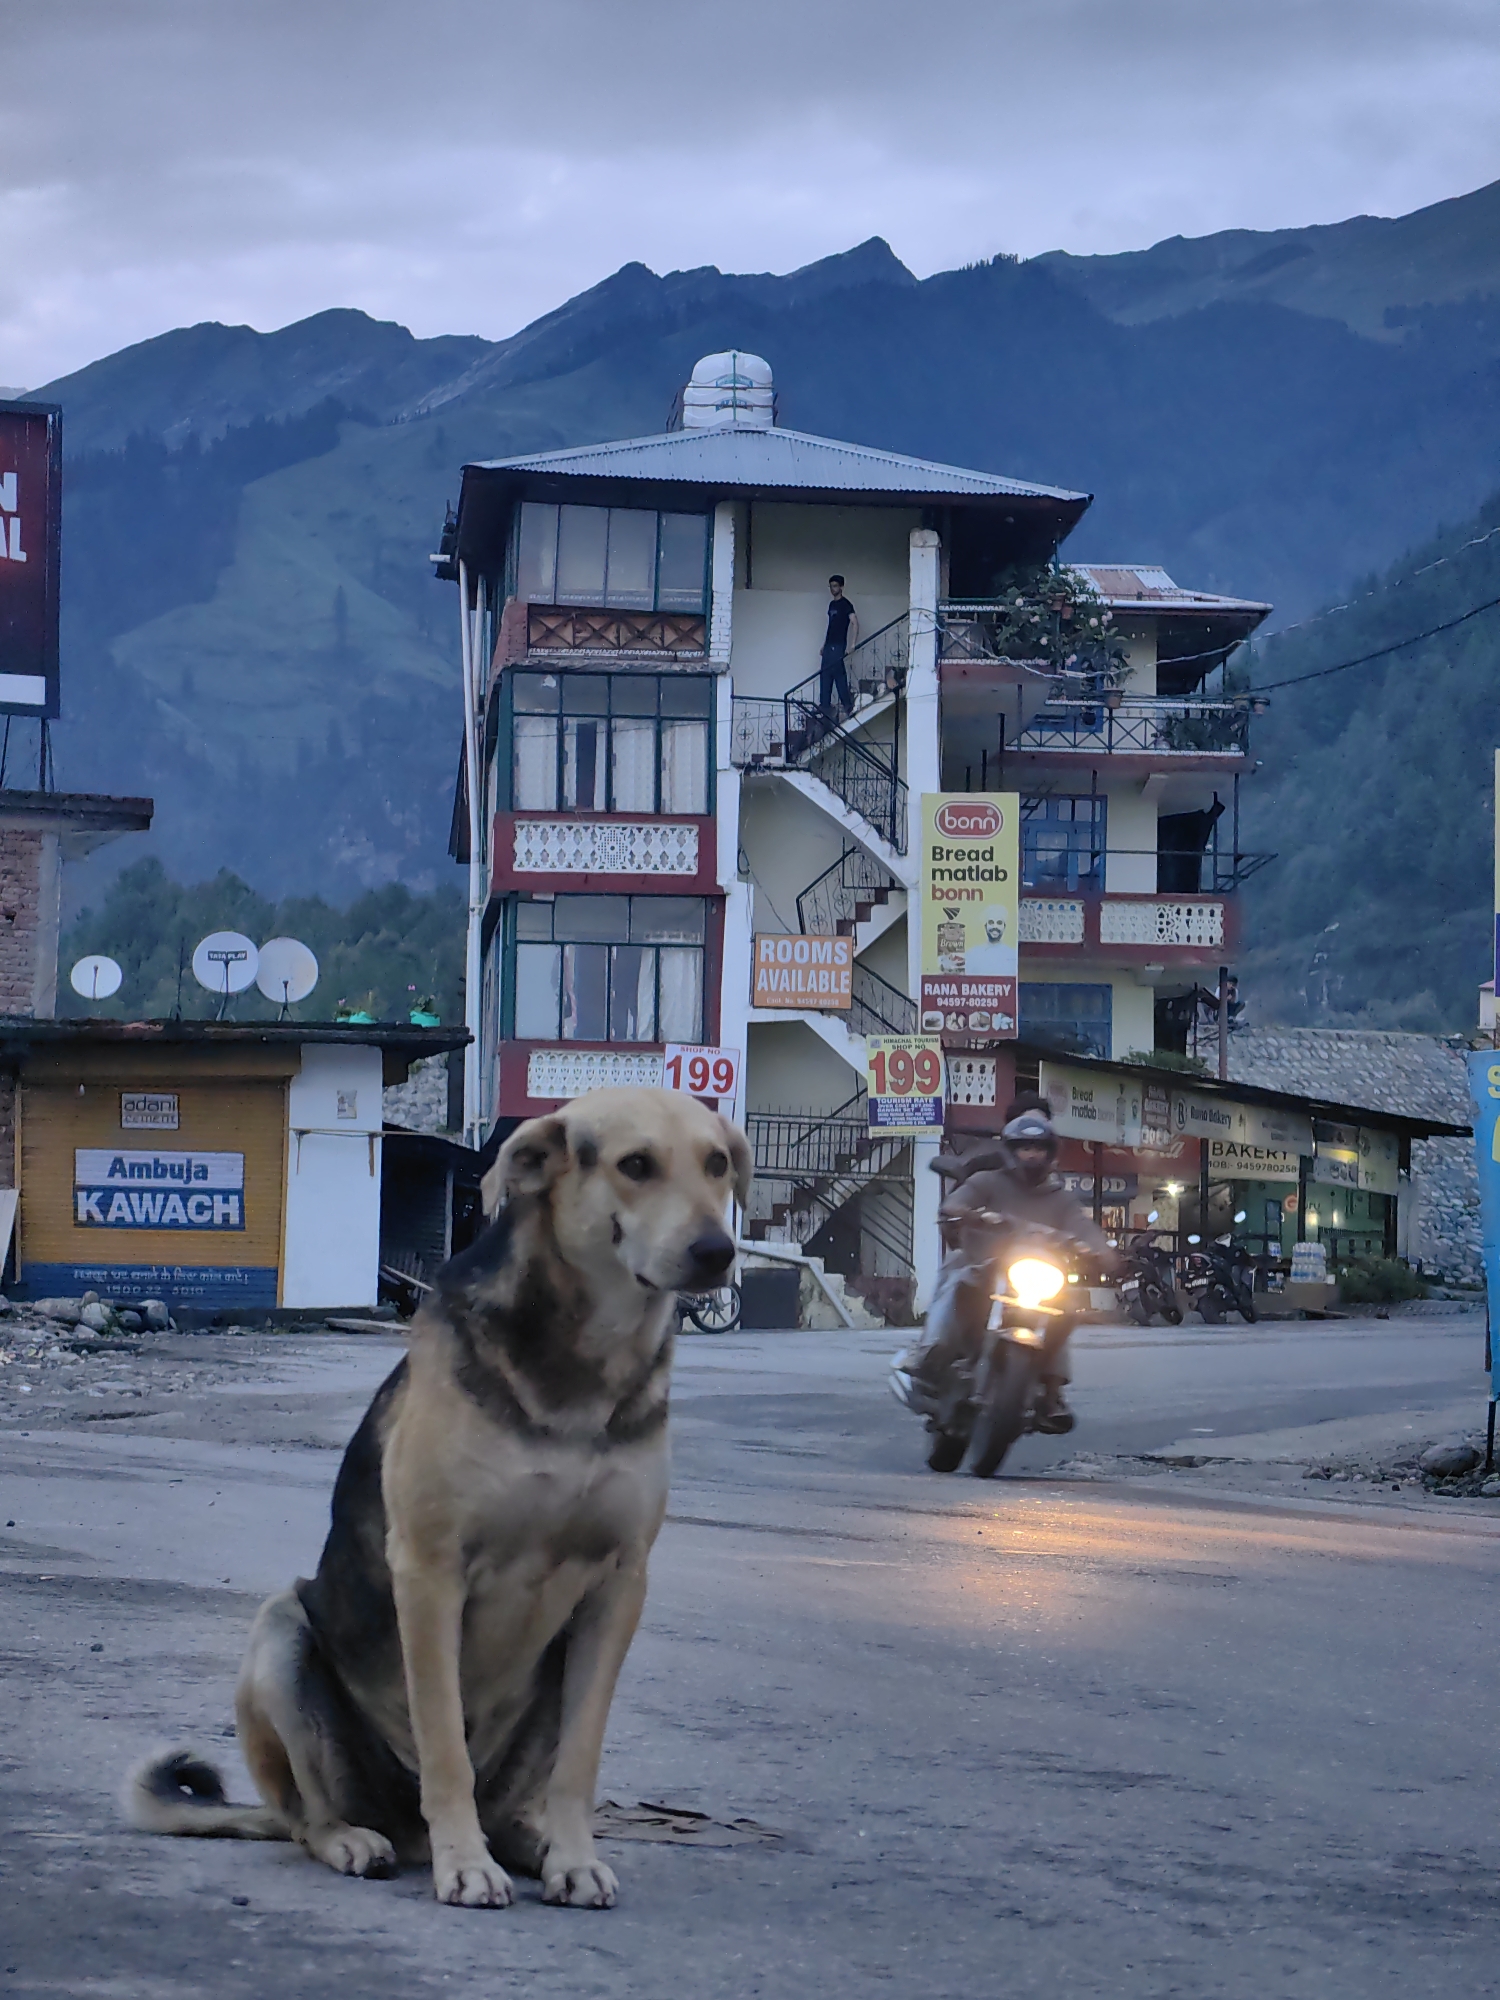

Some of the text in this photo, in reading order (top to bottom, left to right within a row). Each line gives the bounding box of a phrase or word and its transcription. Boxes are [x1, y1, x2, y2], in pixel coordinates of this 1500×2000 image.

[944, 808, 995, 830] bonn
[931, 845, 994, 862] Bread
[931, 864, 1008, 882] matlab
[931, 883, 984, 902] bonn
[760, 939, 848, 965] ROOMS
[757, 967, 850, 994] AVAILABLE
[924, 983, 1011, 997] RANA BAKERY
[680, 1046, 704, 1054] SHOP
[666, 1054, 734, 1095] 199
[869, 1049, 940, 1095] 199
[1072, 1086, 1093, 1102] Bread
[124, 1096, 176, 1112] adani
[106, 1156, 209, 1184] Ambuja
[1236, 1161, 1297, 1173] 9459780258
[77, 1190, 241, 1225] KAWACH
